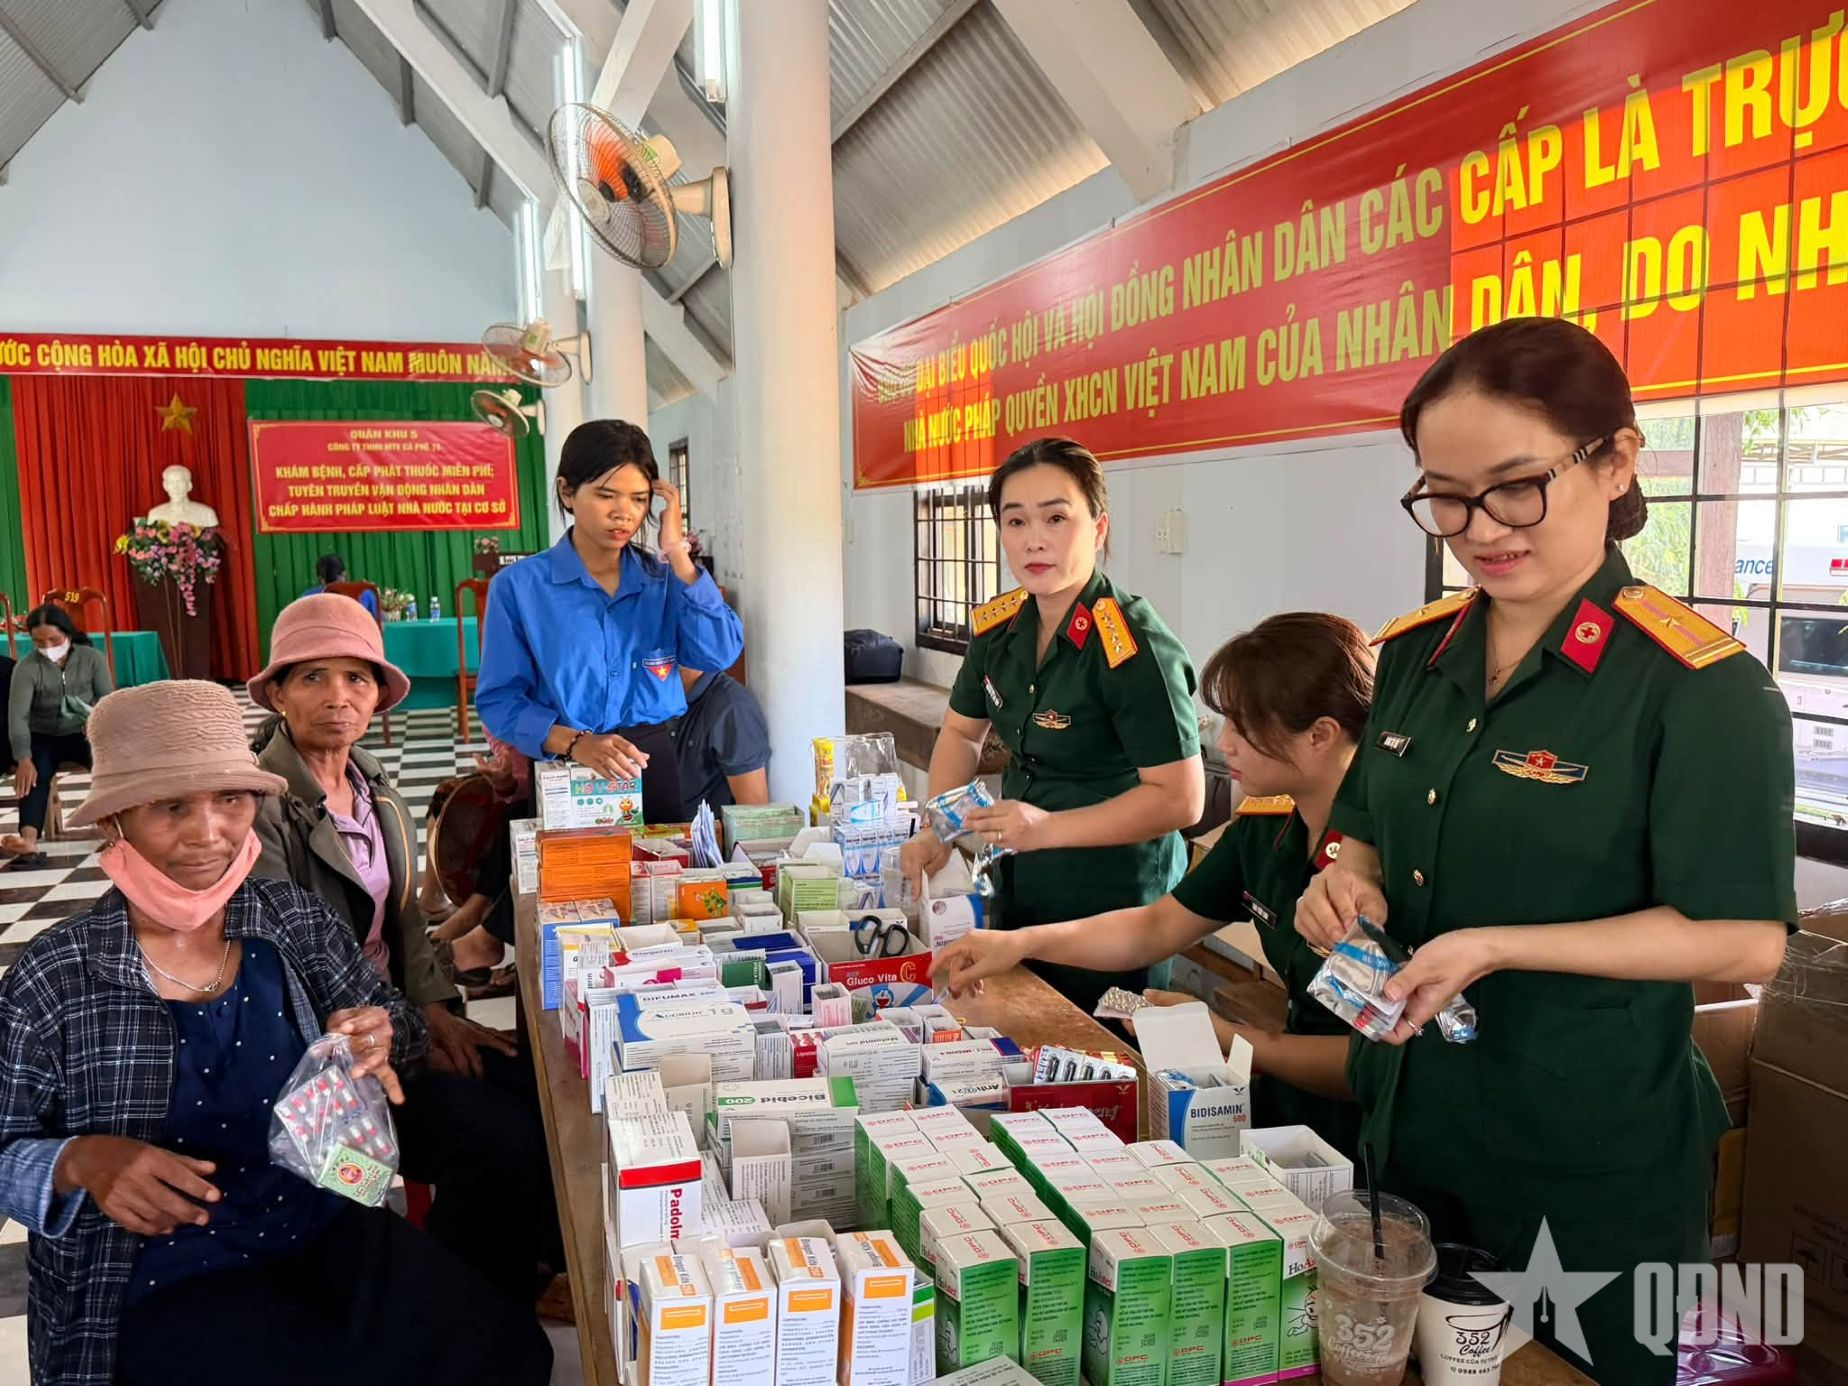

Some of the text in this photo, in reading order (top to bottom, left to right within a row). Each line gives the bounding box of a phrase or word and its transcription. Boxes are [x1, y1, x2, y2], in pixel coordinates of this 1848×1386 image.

[970, 317, 1008, 379] QUỐC
[1012, 309, 1038, 368] HỘI
[1044, 299, 1067, 352] VÀ
[1071, 283, 1104, 349] HỘI
[1111, 260, 1175, 332] ĐỒNG
[1183, 229, 1263, 310] NHÂN
[1273, 200, 1346, 282] DÂN
[1359, 163, 1443, 256] CÁC
[1459, 105, 1564, 225] CẤP
[1583, 73, 1661, 190] LÀ
[1682, 9, 1848, 157] TRỰ
[929, 402, 961, 448] NƯỚC
[965, 392, 1001, 441] PHÁP
[1005, 372, 1058, 437] QUYỀN
[1064, 368, 1118, 423] XHCN
[1124, 347, 1174, 418] VIỆT
[1181, 336, 1246, 400] NAM
[1256, 304, 1324, 386] CỦA
[1336, 281, 1454, 371] NHÂN
[1620, 224, 1711, 321] DO
[36, 339, 93, 372] CỘNG
[98, 340, 139, 368] HÒA
[144, 342, 169, 368] XÃ
[175, 342, 207, 373] HỘI
[213, 340, 250, 370] CHỦ
[256, 345, 314, 372] NGHĨA
[317, 346, 356, 377] VIỆT
[361, 351, 403, 374] NAM
[408, 349, 462, 376] MUÔN
[350, 428, 418, 440] QUÂN KHU 5
[276, 464, 309, 479] KHÁM
[312, 464, 346, 480] BỆNH,
[348, 463, 370, 478] CẤP
[374, 464, 400, 477] PHÁT
[404, 462, 439, 477] THUỐC
[288, 483, 324, 498] TUYÊN
[372, 483, 394, 498] VẬN
[397, 483, 427, 498] ĐỘNG
[430, 482, 460, 496] NHÂN
[462, 481, 485, 495] DÂN
[269, 498, 506, 518] CHẤP HÀNH PHÁP LUẬT NHÀ NƯỚC TẠI CƠ SỞ
[846, 976, 875, 987] Gluco
[878, 973, 898, 983] Vita
[1190, 1104, 1243, 1119] BIDISAMIN
[1334, 1312, 1395, 1353] 352
[1456, 1330, 1490, 1346] 352
[1459, 1344, 1491, 1358] Coffee
